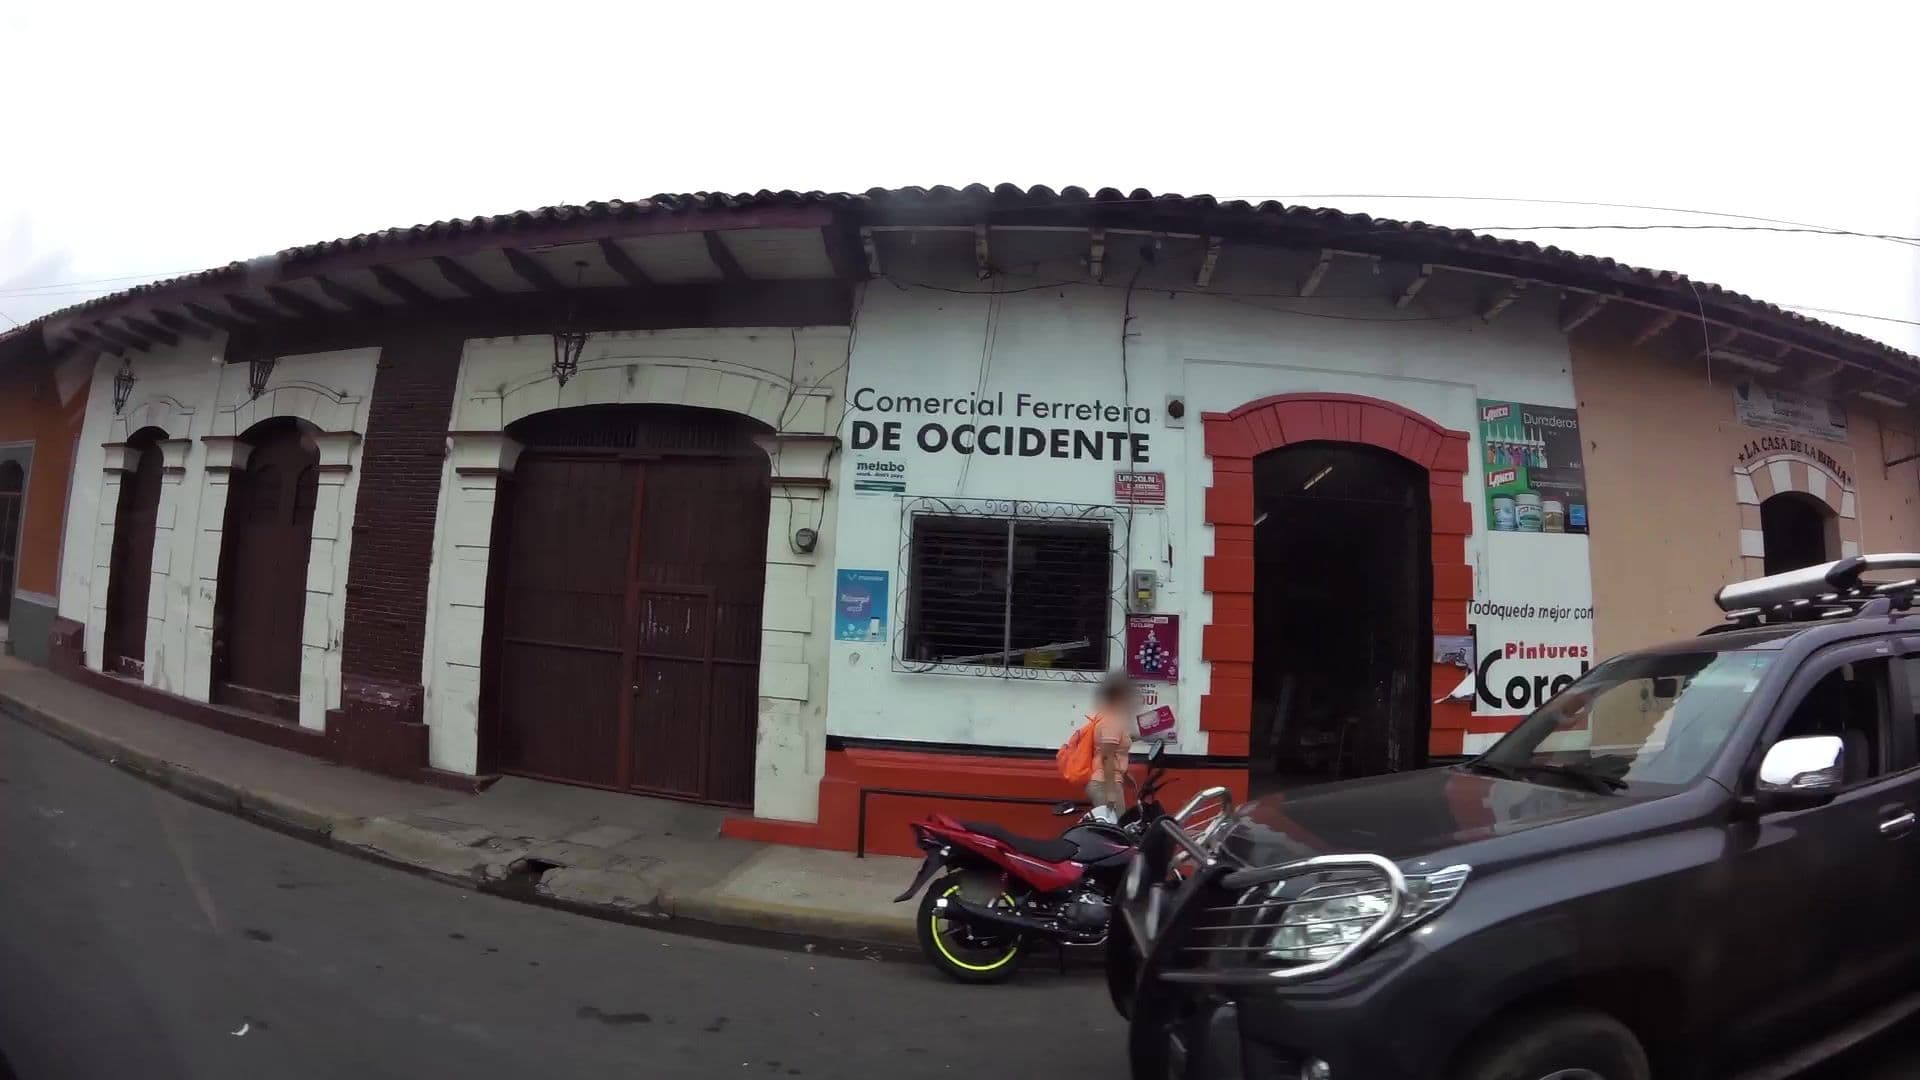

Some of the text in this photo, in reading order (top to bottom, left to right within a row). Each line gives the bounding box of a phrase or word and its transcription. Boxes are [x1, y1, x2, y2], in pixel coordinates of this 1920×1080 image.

[853, 387, 1150, 424] Comercial Ferretera
[1523, 412, 1577, 429] Duraderos
[851, 420, 1150, 463] DE OCCIDENTE
[856, 461, 905, 472] metabo
[1743, 437, 1847, 483] LA CASA DE LA BIBLIA
[1538, 604, 1571, 622] mejor
[1573, 605, 1594, 620] con
[1505, 641, 1589, 660] Pinturas
